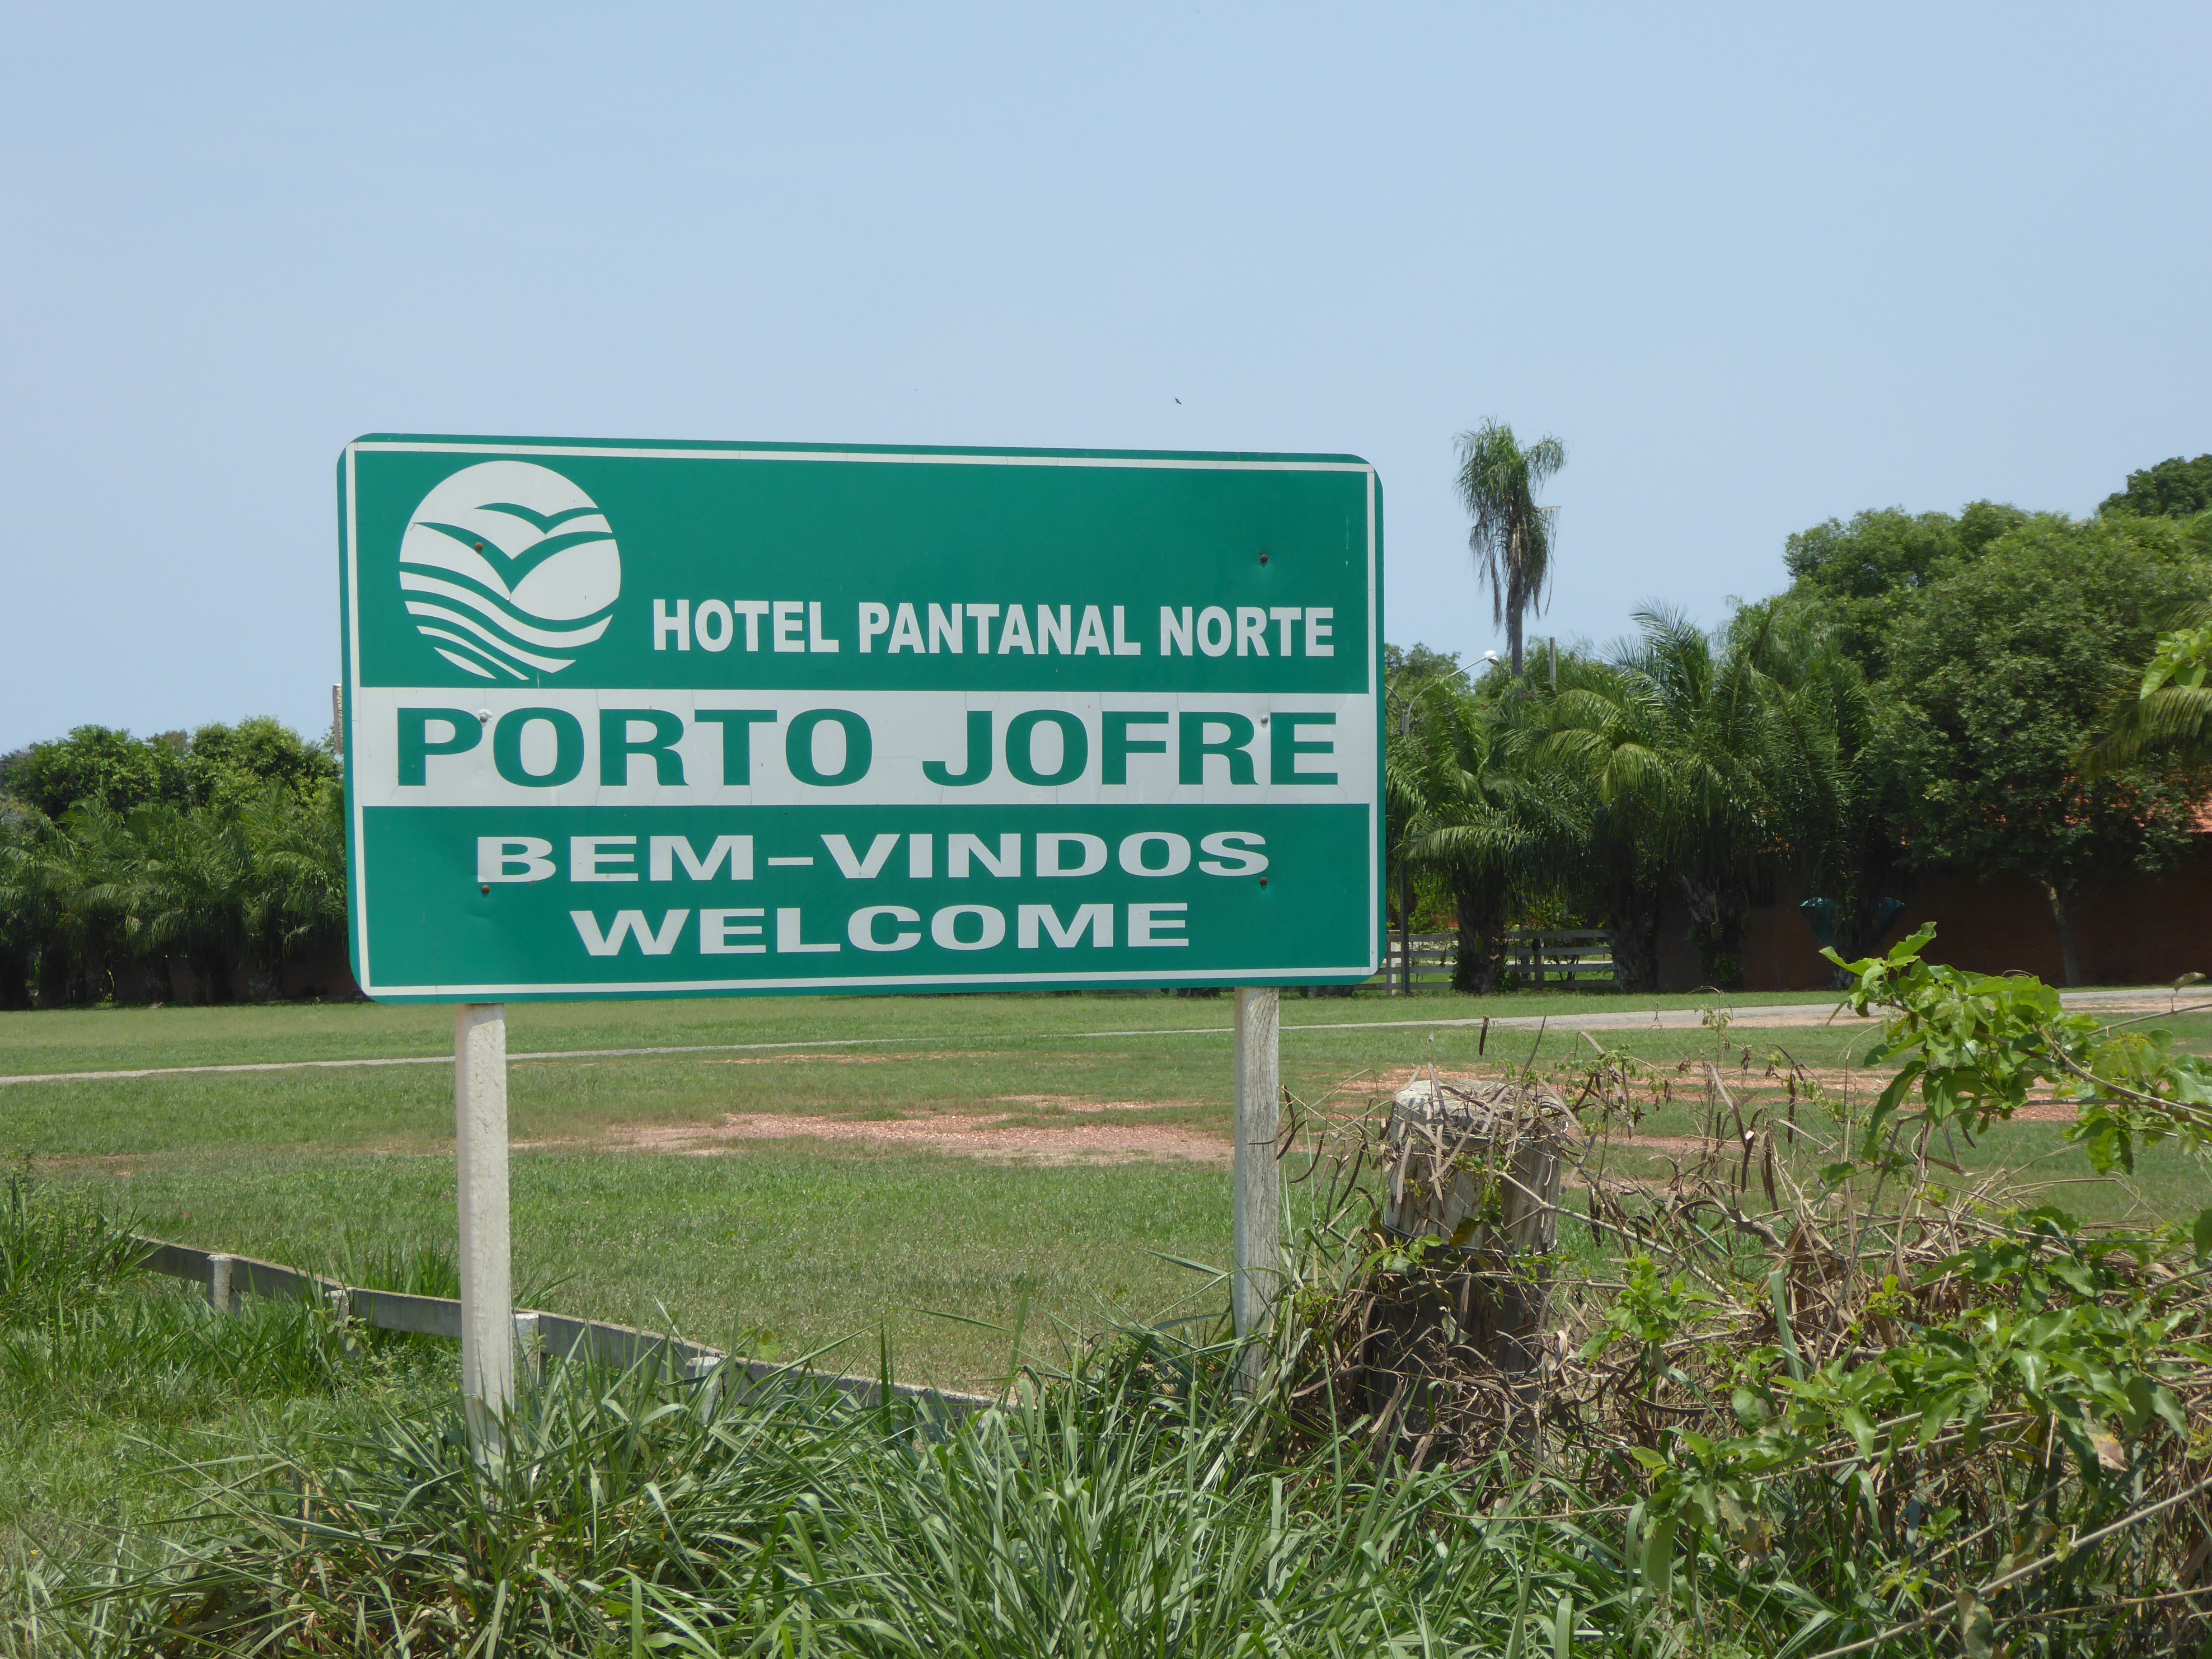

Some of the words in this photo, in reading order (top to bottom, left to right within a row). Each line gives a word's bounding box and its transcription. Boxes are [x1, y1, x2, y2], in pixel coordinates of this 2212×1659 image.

[654, 599, 839, 652] HOTEL
[859, 602, 1140, 655] PANTANAL
[1161, 606, 1334, 656] NORTE
[398, 708, 872, 787] PORTO
[923, 710, 1338, 786] JOFRE
[478, 832, 1268, 882] BEM-VINDOS
[570, 903, 1189, 956] WELCOME
